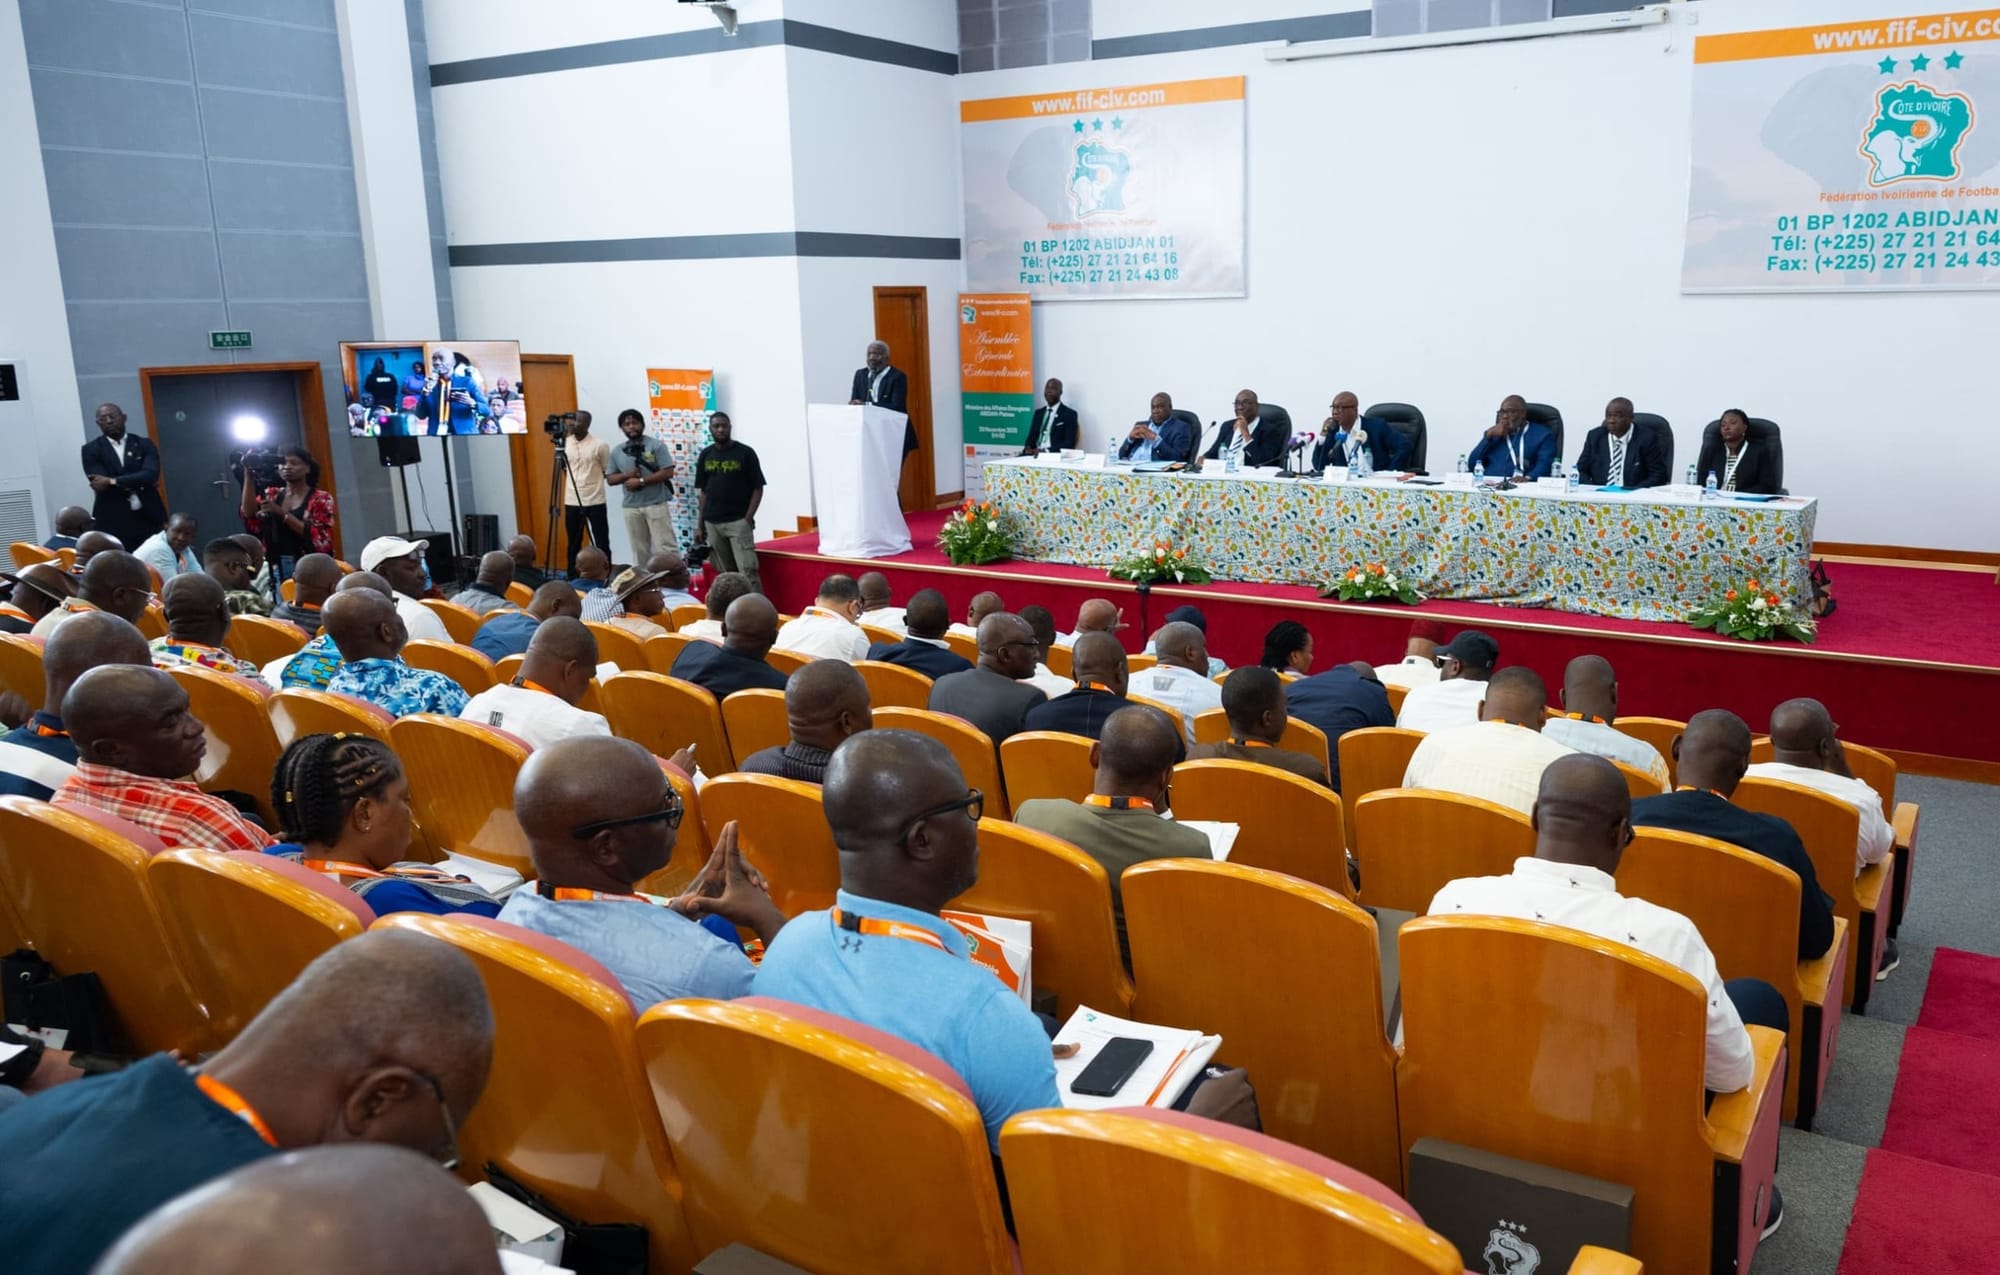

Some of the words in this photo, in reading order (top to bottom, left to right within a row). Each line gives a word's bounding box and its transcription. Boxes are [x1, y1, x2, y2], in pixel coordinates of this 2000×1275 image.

[1031, 88, 1166, 114] www.fif-civ.com
[1819, 191, 1878, 204] Fédération
[1881, 189, 1937, 201] Ivoirienne
[1941, 187, 1955, 198] de
[1777, 215, 1798, 231] 01
[1807, 214, 1835, 230] BP
[1842, 212, 1888, 229] 1202
[1894, 208, 1998, 227] ABIDJAN
[1023, 240, 1036, 253] 01
[1041, 239, 1058, 252] BP
[1062, 238, 1090, 252] 1202
[1094, 236, 1155, 250] ABIDJAN
[1159, 235, 1174, 248] 01
[1771, 235, 1807, 251] Tél:
[1814, 233, 1875, 254] (+225)
[1882, 232, 1906, 248] 27
[1912, 231, 1935, 247] 21
[1944, 230, 1967, 247] 21
[1976, 229, 2000, 246] 64
[1047, 254, 1084, 270] (+225)
[1087, 254, 1102, 266] 27
[1106, 253, 1119, 266] 21
[1124, 252, 1138, 265] 21
[1142, 252, 1158, 264] 64
[1163, 251, 1177, 264] 16
[1767, 255, 1808, 271] Fax:
[1815, 253, 1876, 274] (+225)
[1883, 252, 1907, 269] 27
[1913, 252, 1936, 268] 21
[1944, 251, 1969, 268] 24
[1976, 250, 2000, 267] 43
[1019, 271, 1045, 284] Fax:
[1049, 270, 1086, 286] (+225)
[1089, 269, 1104, 282] 27
[1107, 269, 1121, 282] 21
[1126, 268, 1141, 281] 24
[1144, 267, 1160, 281] 43
[1163, 267, 1179, 280] 08
